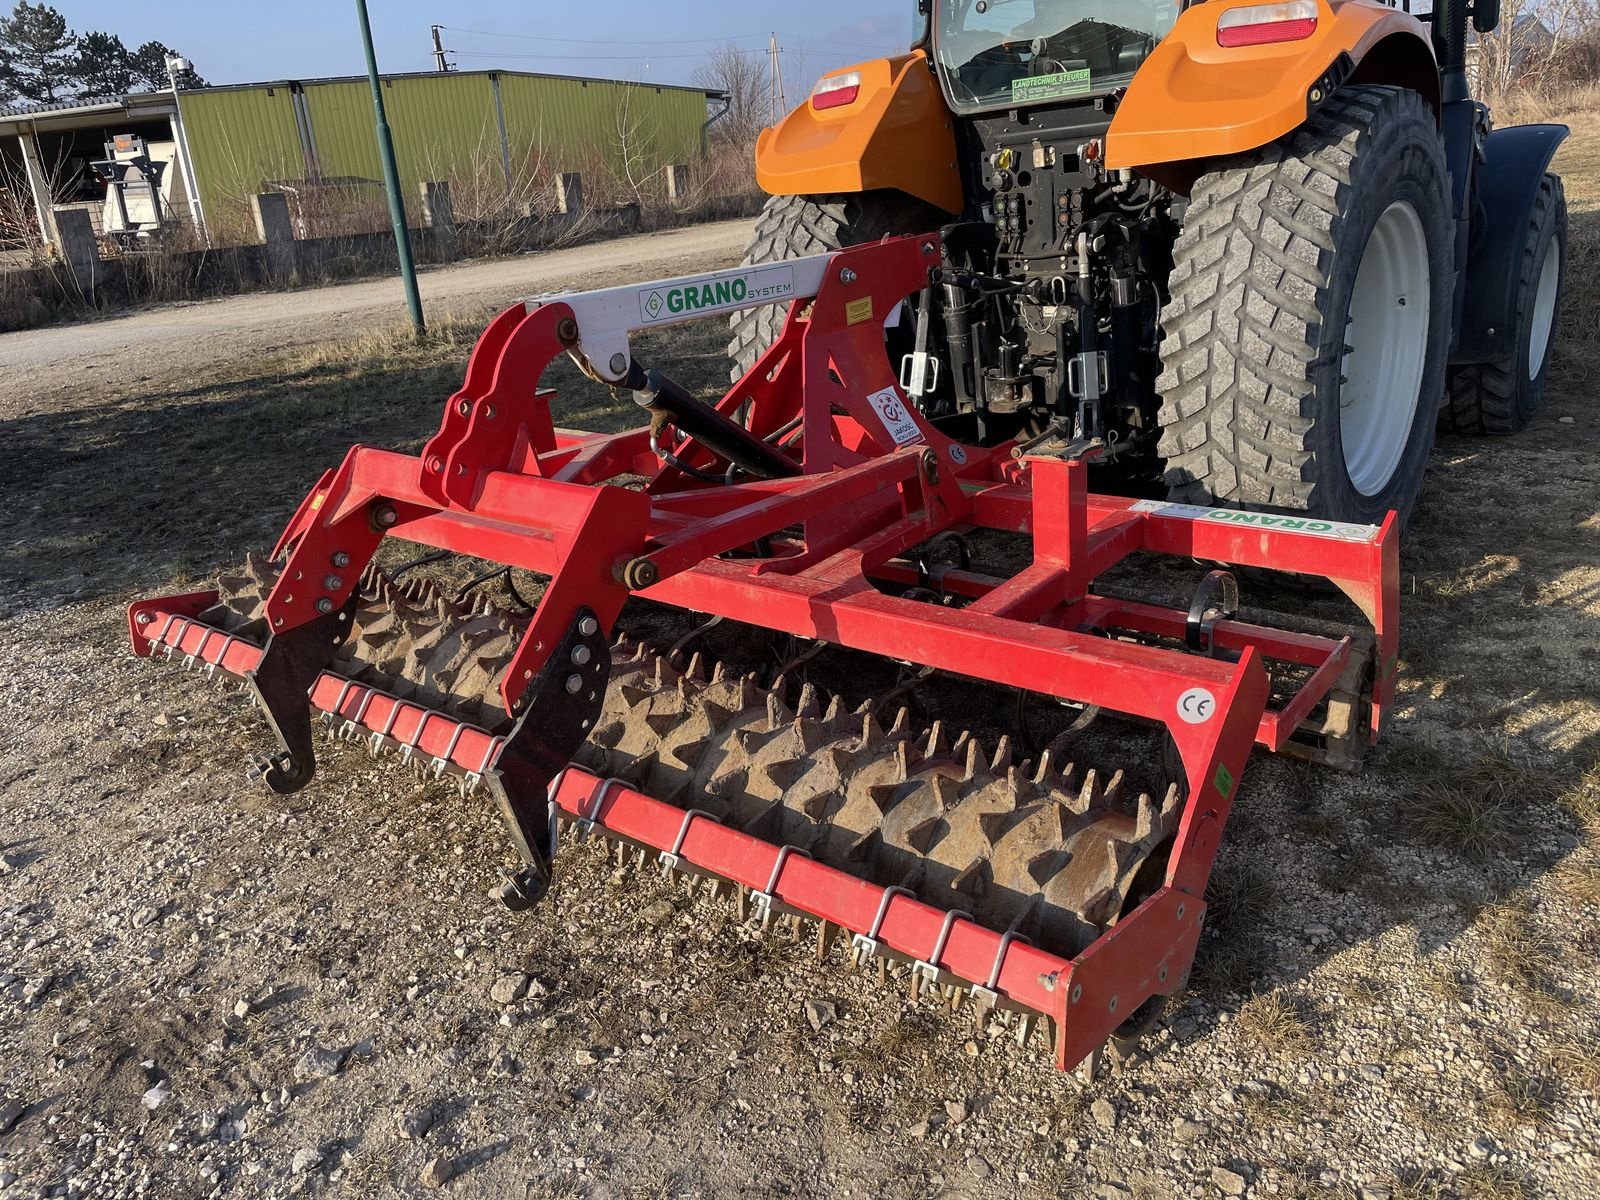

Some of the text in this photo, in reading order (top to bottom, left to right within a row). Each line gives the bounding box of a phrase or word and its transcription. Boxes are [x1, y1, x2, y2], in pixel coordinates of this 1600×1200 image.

[1014, 71, 1089, 88] LANDTECHNIK STEURER
[666, 278, 791, 313] GRANO SYSTEM
[1208, 511, 1333, 532] GRANO
[1182, 694, 1211, 717] CE
